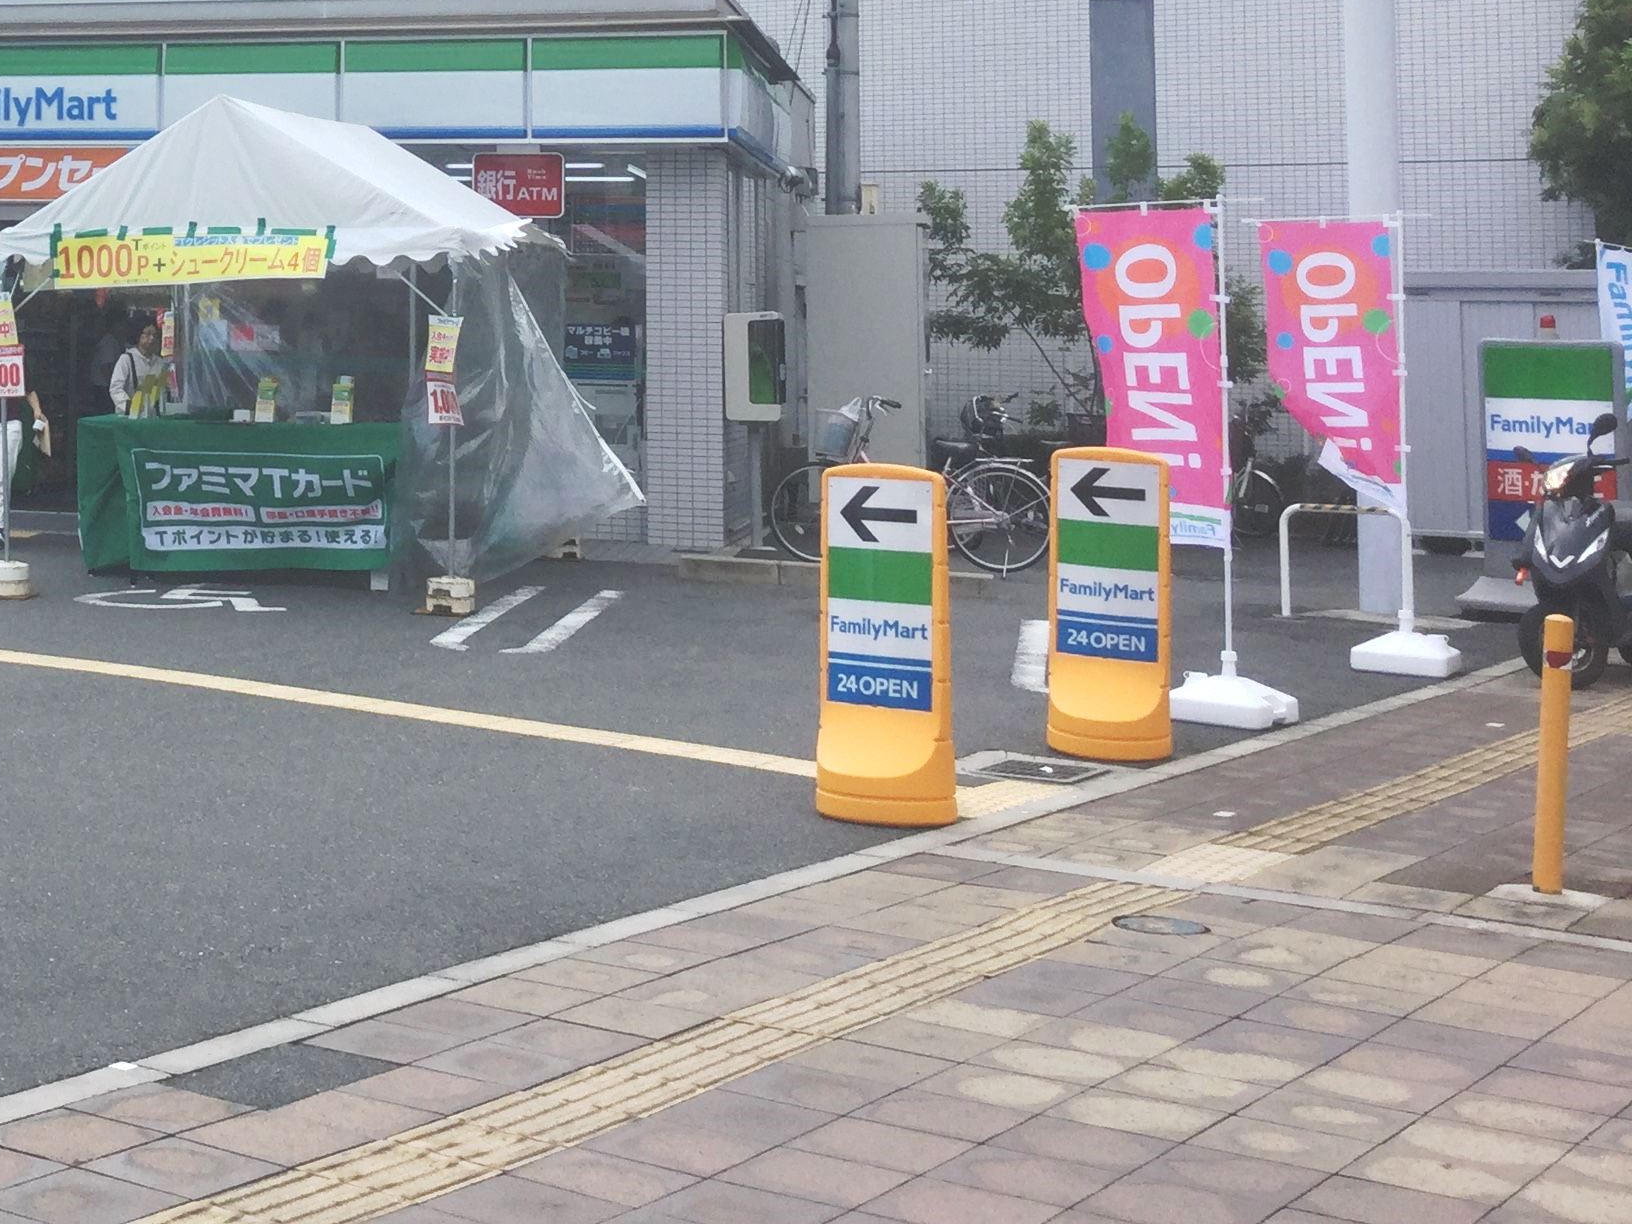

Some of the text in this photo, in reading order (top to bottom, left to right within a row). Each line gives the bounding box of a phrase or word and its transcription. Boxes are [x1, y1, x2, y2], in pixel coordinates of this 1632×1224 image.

[1490, 414, 1594, 438] FamilyMa
[145, 462, 372, 498] ファミマTカード
[1060, 578, 1155, 602] FamilyMart
[830, 616, 928, 641] FamilyMart
